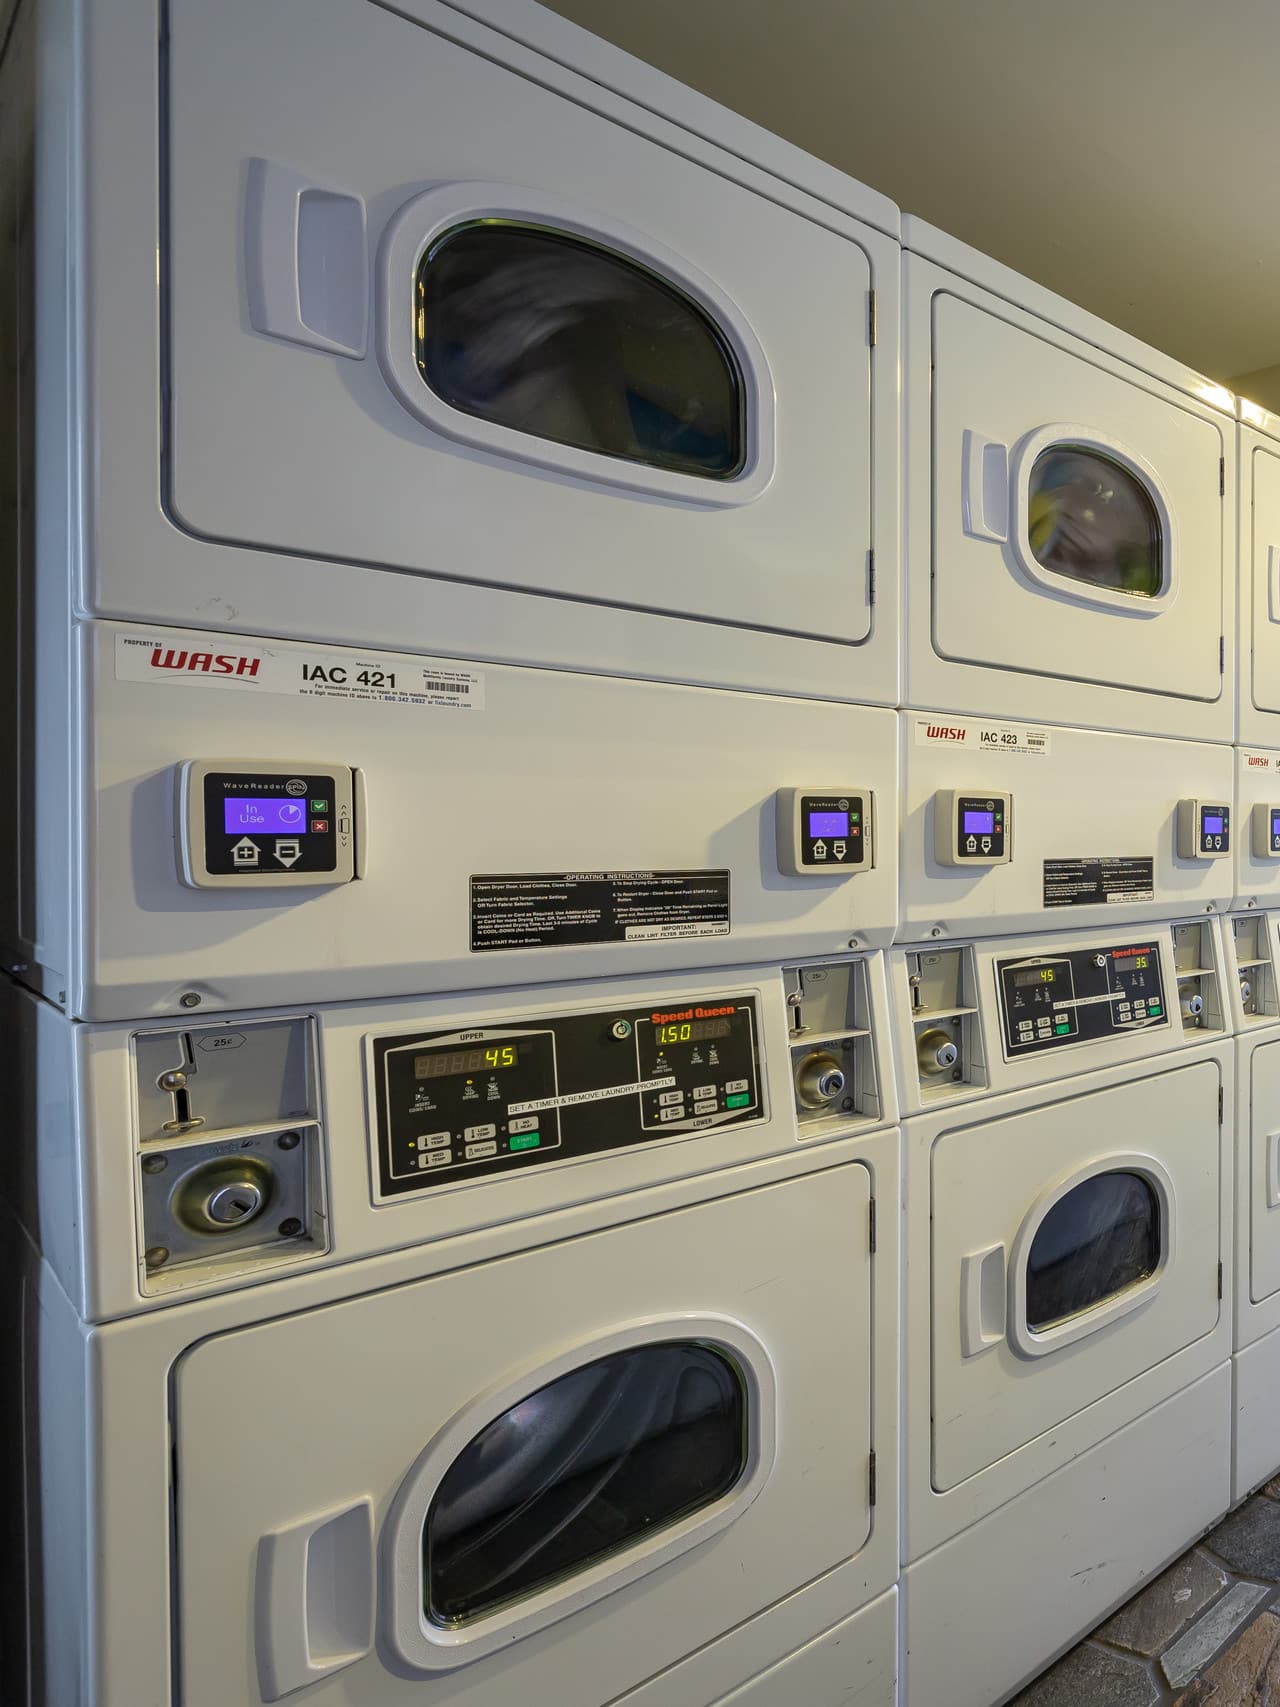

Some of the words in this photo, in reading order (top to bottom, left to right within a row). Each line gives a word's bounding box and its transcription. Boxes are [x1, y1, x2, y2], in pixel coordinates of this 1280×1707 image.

[124, 639, 153, 647] PROPERTY
[151, 649, 260, 676] WASH
[303, 664, 347, 683] IAC
[357, 671, 395, 688] 421
[927, 726, 965, 740] WASH
[981, 731, 998, 742] IAC
[1001, 734, 1017, 744] 423
[1248, 757, 1269, 767] WASH
[246, 804, 257, 813] In
[240, 815, 264, 823] Use
[1041, 969, 1053, 982] 45
[651, 1009, 693, 1024] Speed
[695, 1006, 735, 1018] Queen
[460, 1032, 484, 1040] UPPER
[661, 1024, 690, 1043] 1.50
[486, 1048, 514, 1066] 45
[510, 1105, 525, 1113] SET
[535, 1099, 559, 1109] TIMER
[568, 1091, 601, 1103] REMOVE
[602, 1085, 634, 1097] LAUNDRY
[637, 1078, 674, 1090] PROMPTLY
[693, 1118, 712, 1127] LOWER
